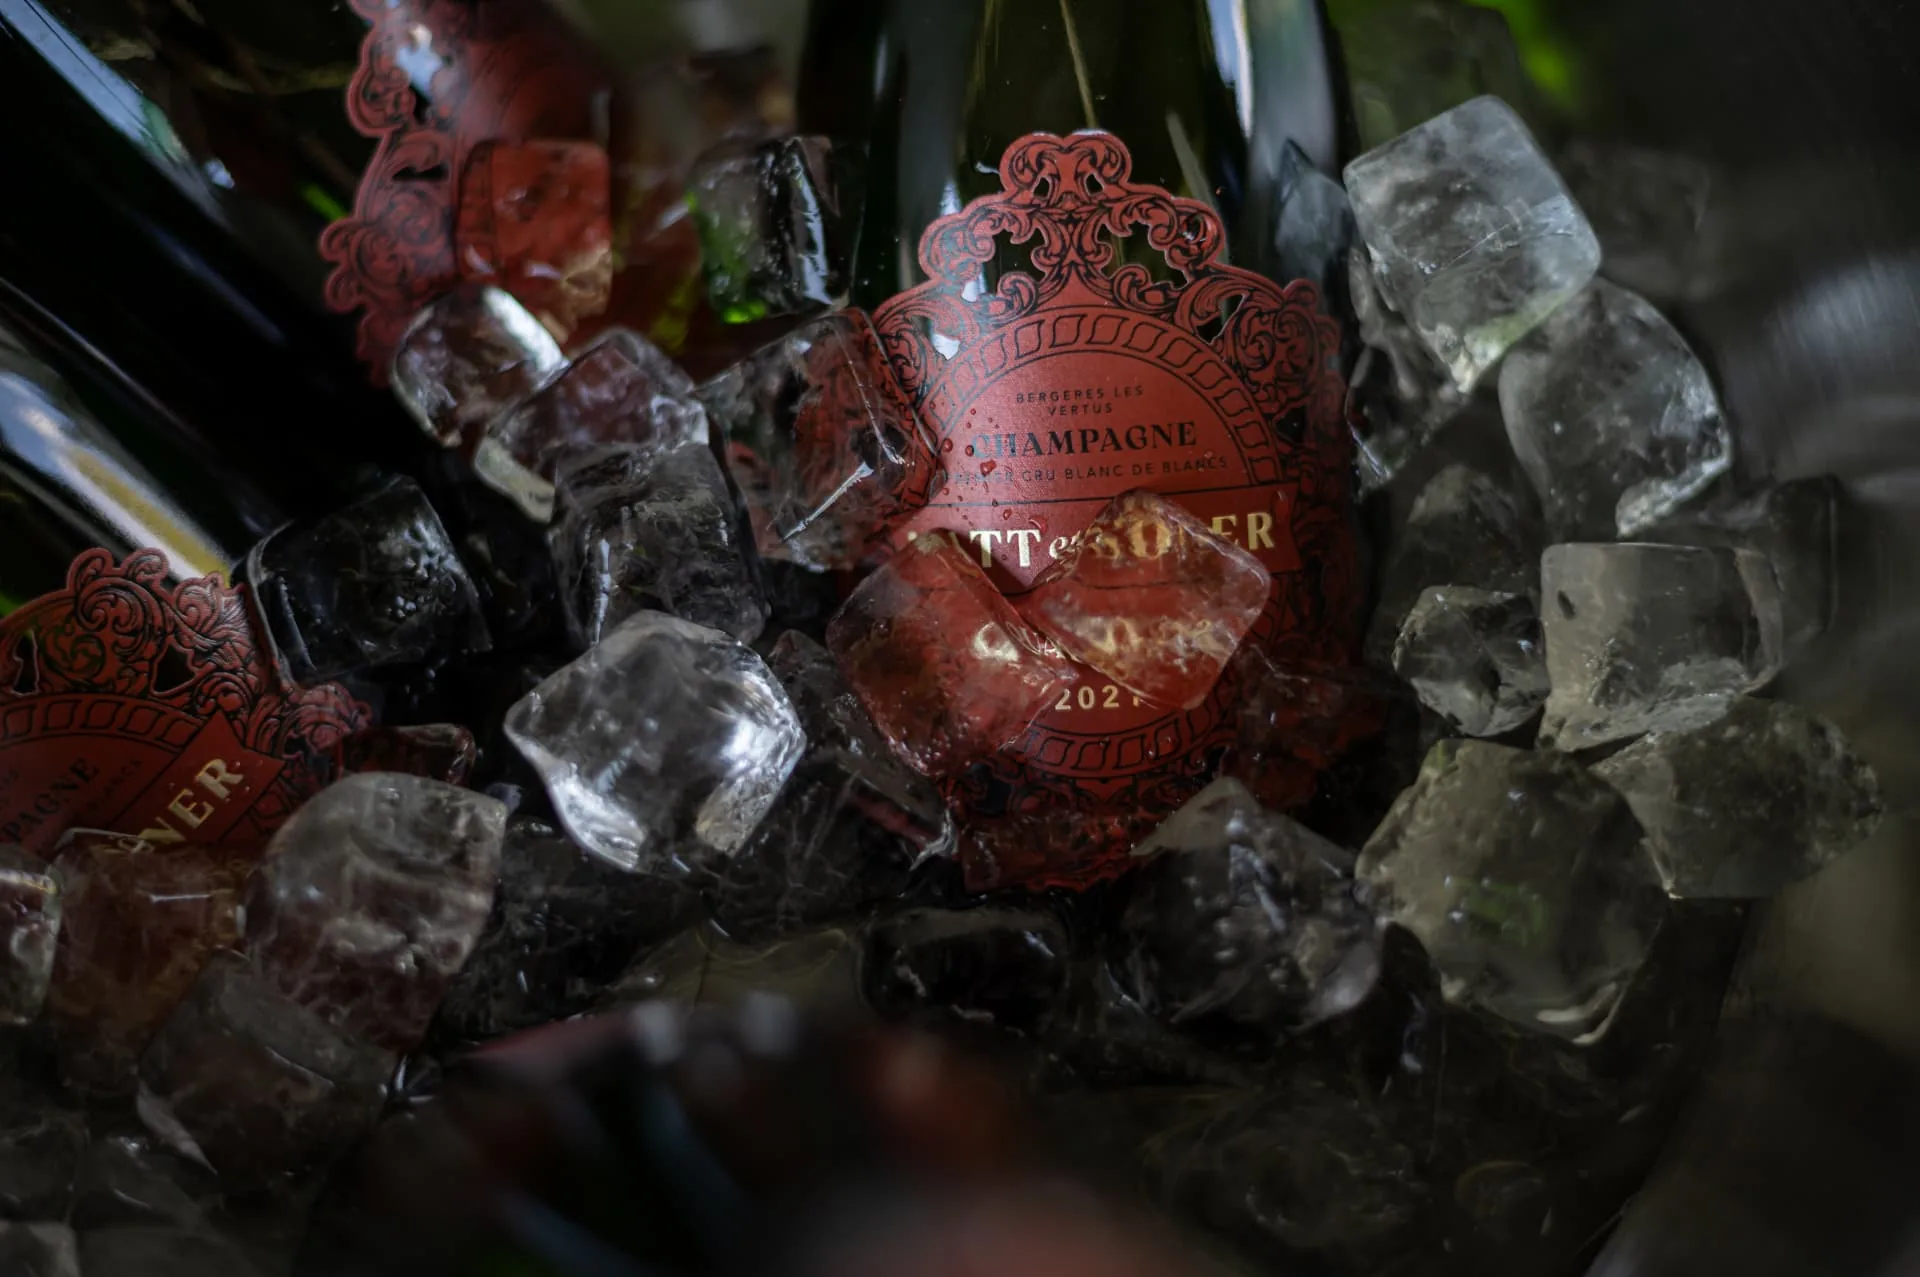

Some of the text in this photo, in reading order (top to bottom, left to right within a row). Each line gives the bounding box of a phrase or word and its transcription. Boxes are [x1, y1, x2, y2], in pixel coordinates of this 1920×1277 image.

[1016, 384, 1144, 405] BERGERES LES
[1048, 402, 1113, 417] VERTUS
[972, 420, 1198, 460] CHAMPAGNE
[1065, 464, 1124, 481] BLANC
[1132, 461, 1150, 475] DE
[1162, 456, 1228, 474] BLANCS
[1054, 684, 1140, 711] 202
